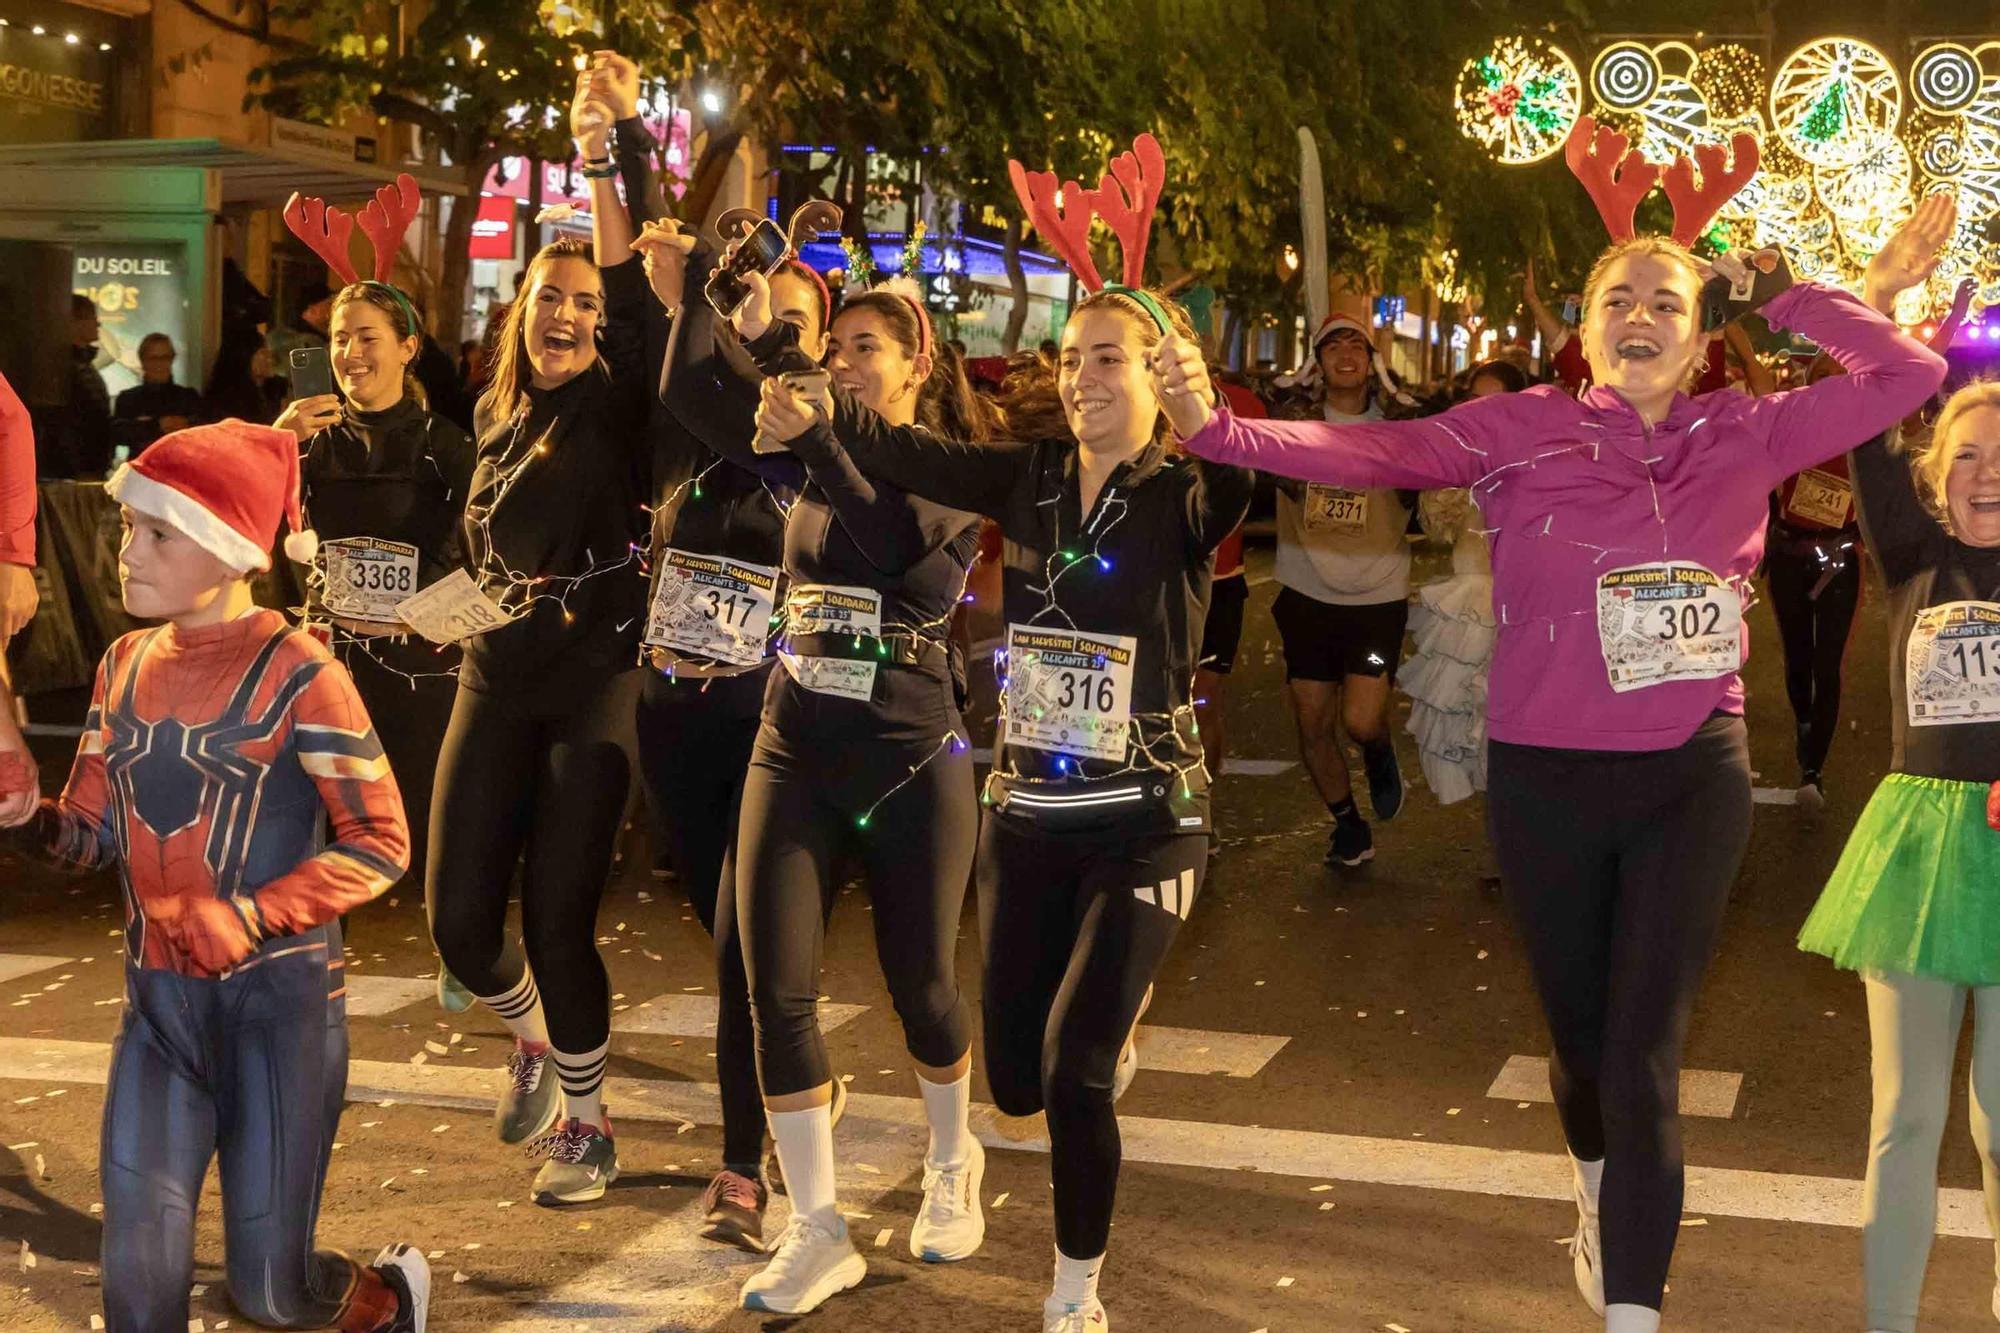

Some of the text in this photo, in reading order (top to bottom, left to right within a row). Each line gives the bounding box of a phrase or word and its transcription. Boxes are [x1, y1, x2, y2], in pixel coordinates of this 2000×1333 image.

[77, 257, 171, 276] DU SOLEIL
[1815, 489, 1842, 509] 241
[1326, 500, 1362, 521] 2371
[375, 541, 413, 558] SOLIDARIA
[353, 562, 411, 592] 3368
[670, 554, 772, 588] SAN SILVESTRE SOLIDARIA
[1622, 572, 1668, 584] SILVESTRE
[694, 573, 735, 590] ALICANTE
[826, 594, 875, 612] SOLIDARIA
[1635, 586, 1687, 600] ALICANTE
[703, 590, 759, 628] 317
[1659, 602, 1721, 641] 302
[1014, 634, 1128, 663] SAN SILVESTRE SOLIDARIA
[1042, 654, 1088, 667] ALICANTE
[1057, 671, 1115, 713] 316
